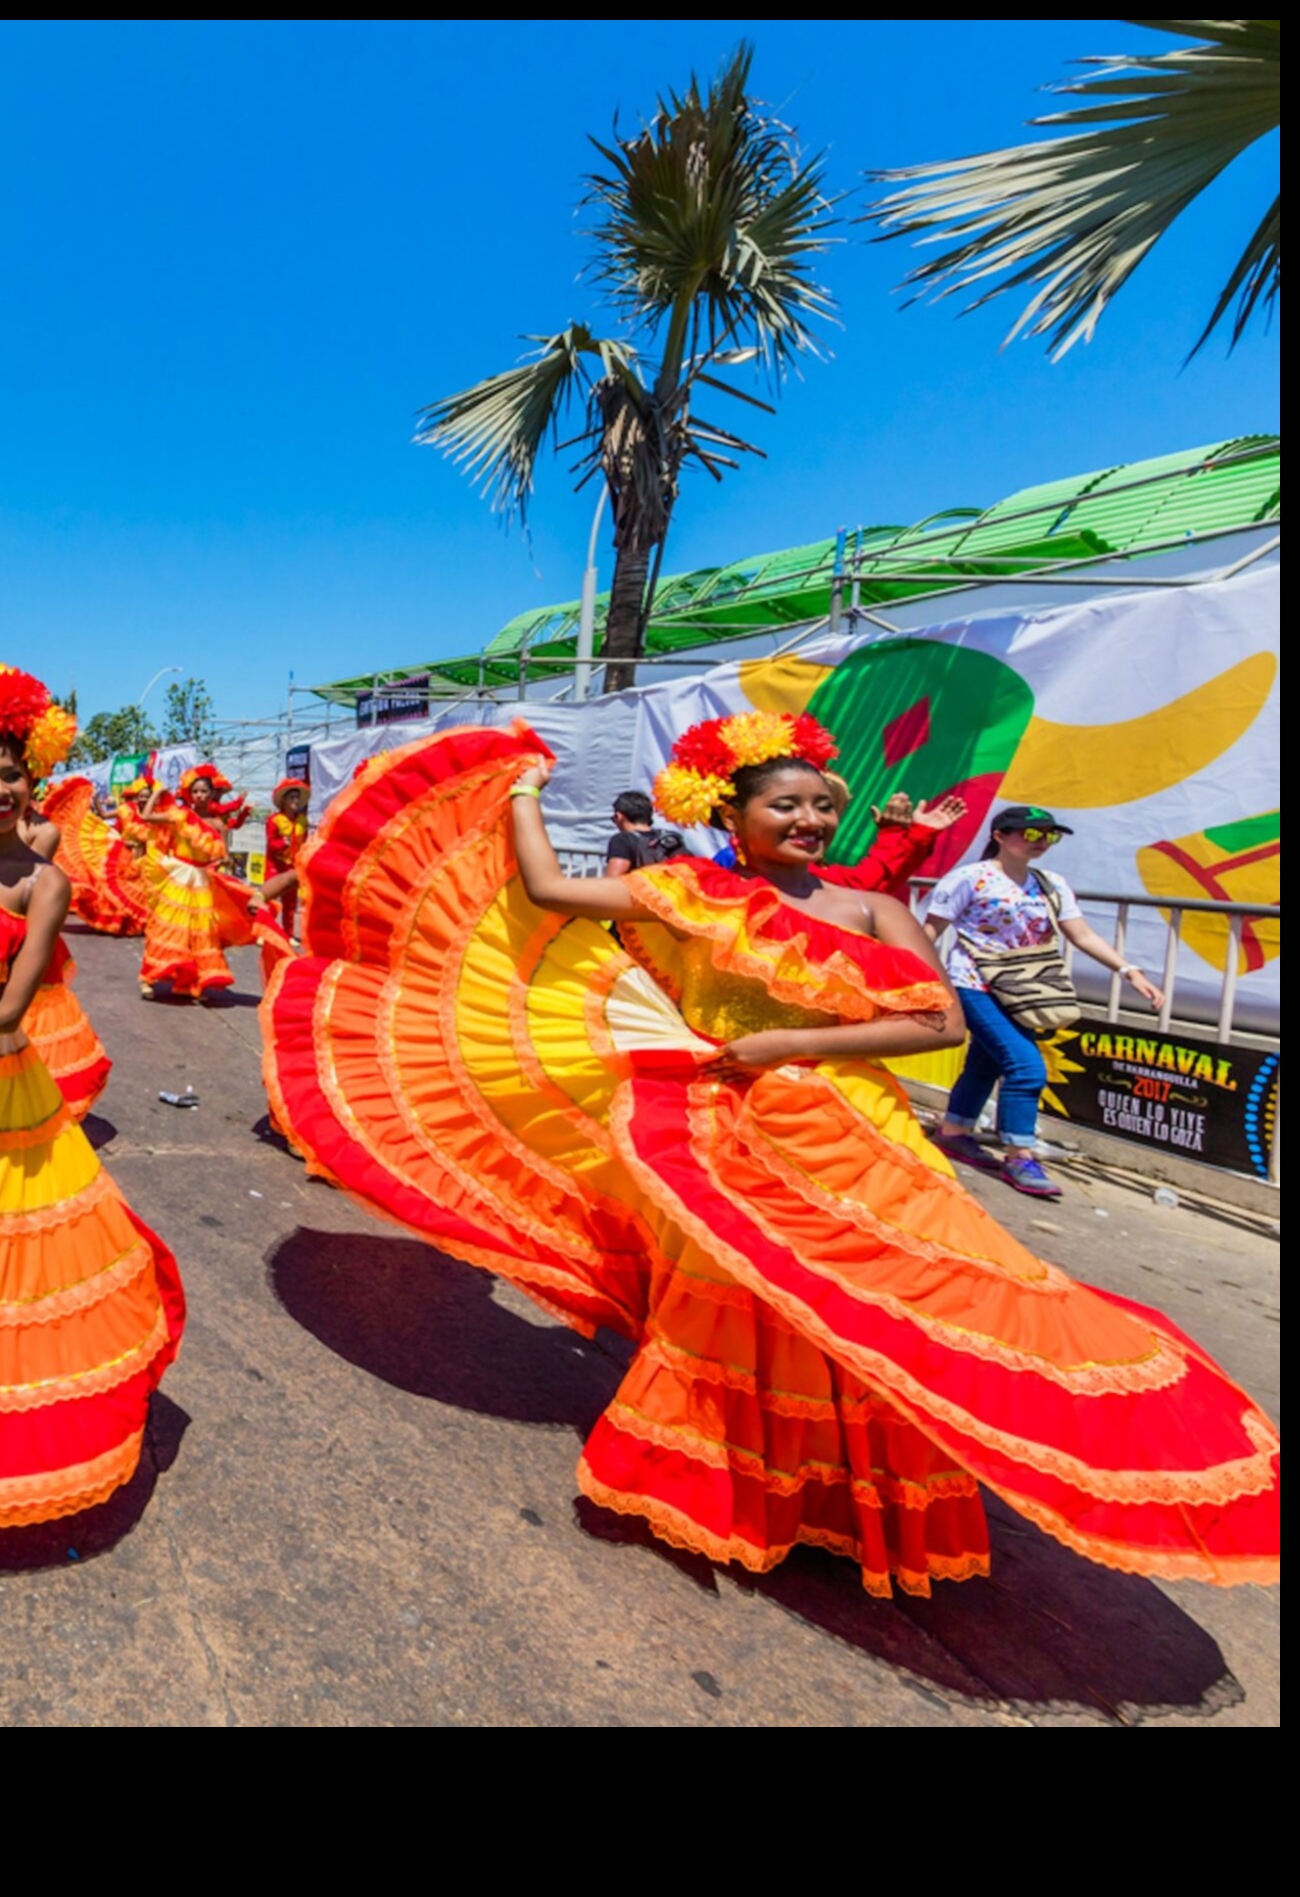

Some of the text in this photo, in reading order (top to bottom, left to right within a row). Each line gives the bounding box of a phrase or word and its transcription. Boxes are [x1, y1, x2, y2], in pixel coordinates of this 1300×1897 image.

[1081, 1033, 1237, 1091] CARNAVAL
[1125, 1063, 1199, 1089] BARRANQUILLA
[1133, 1076, 1171, 1102] 2017
[1098, 1089, 1205, 1134] QUIEN LO VIVE
[1103, 1108, 1203, 1152] ES QUIEN LO GOZA
